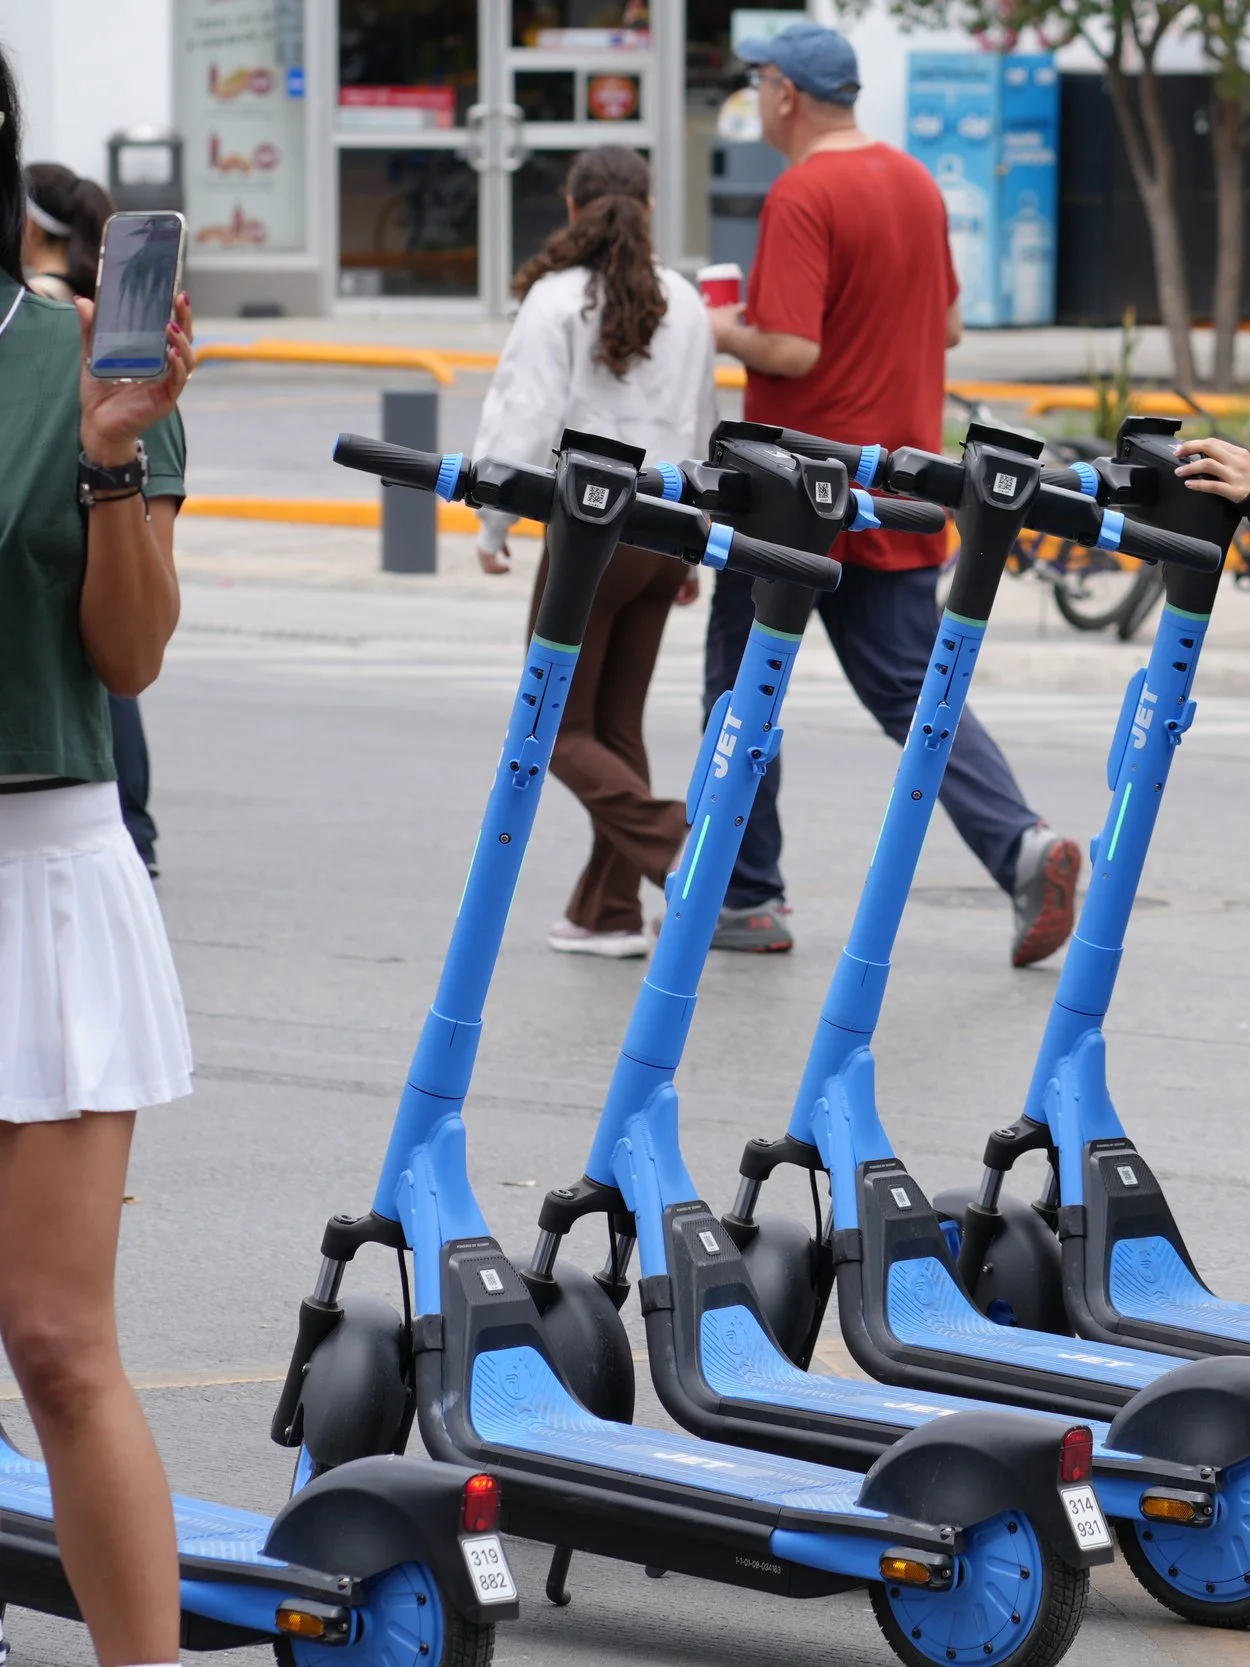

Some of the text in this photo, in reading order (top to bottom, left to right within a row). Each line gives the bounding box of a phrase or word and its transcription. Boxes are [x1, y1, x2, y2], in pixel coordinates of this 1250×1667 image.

[1131, 682, 1158, 749] JET
[712, 706, 742, 778] JET
[1057, 1353, 1135, 1367] JET
[653, 1452, 735, 1468] JET
[1069, 1497, 1093, 1515] 314
[1077, 1519, 1101, 1537] 931
[471, 1548, 499, 1566] 319
[480, 1572, 507, 1590] 882
